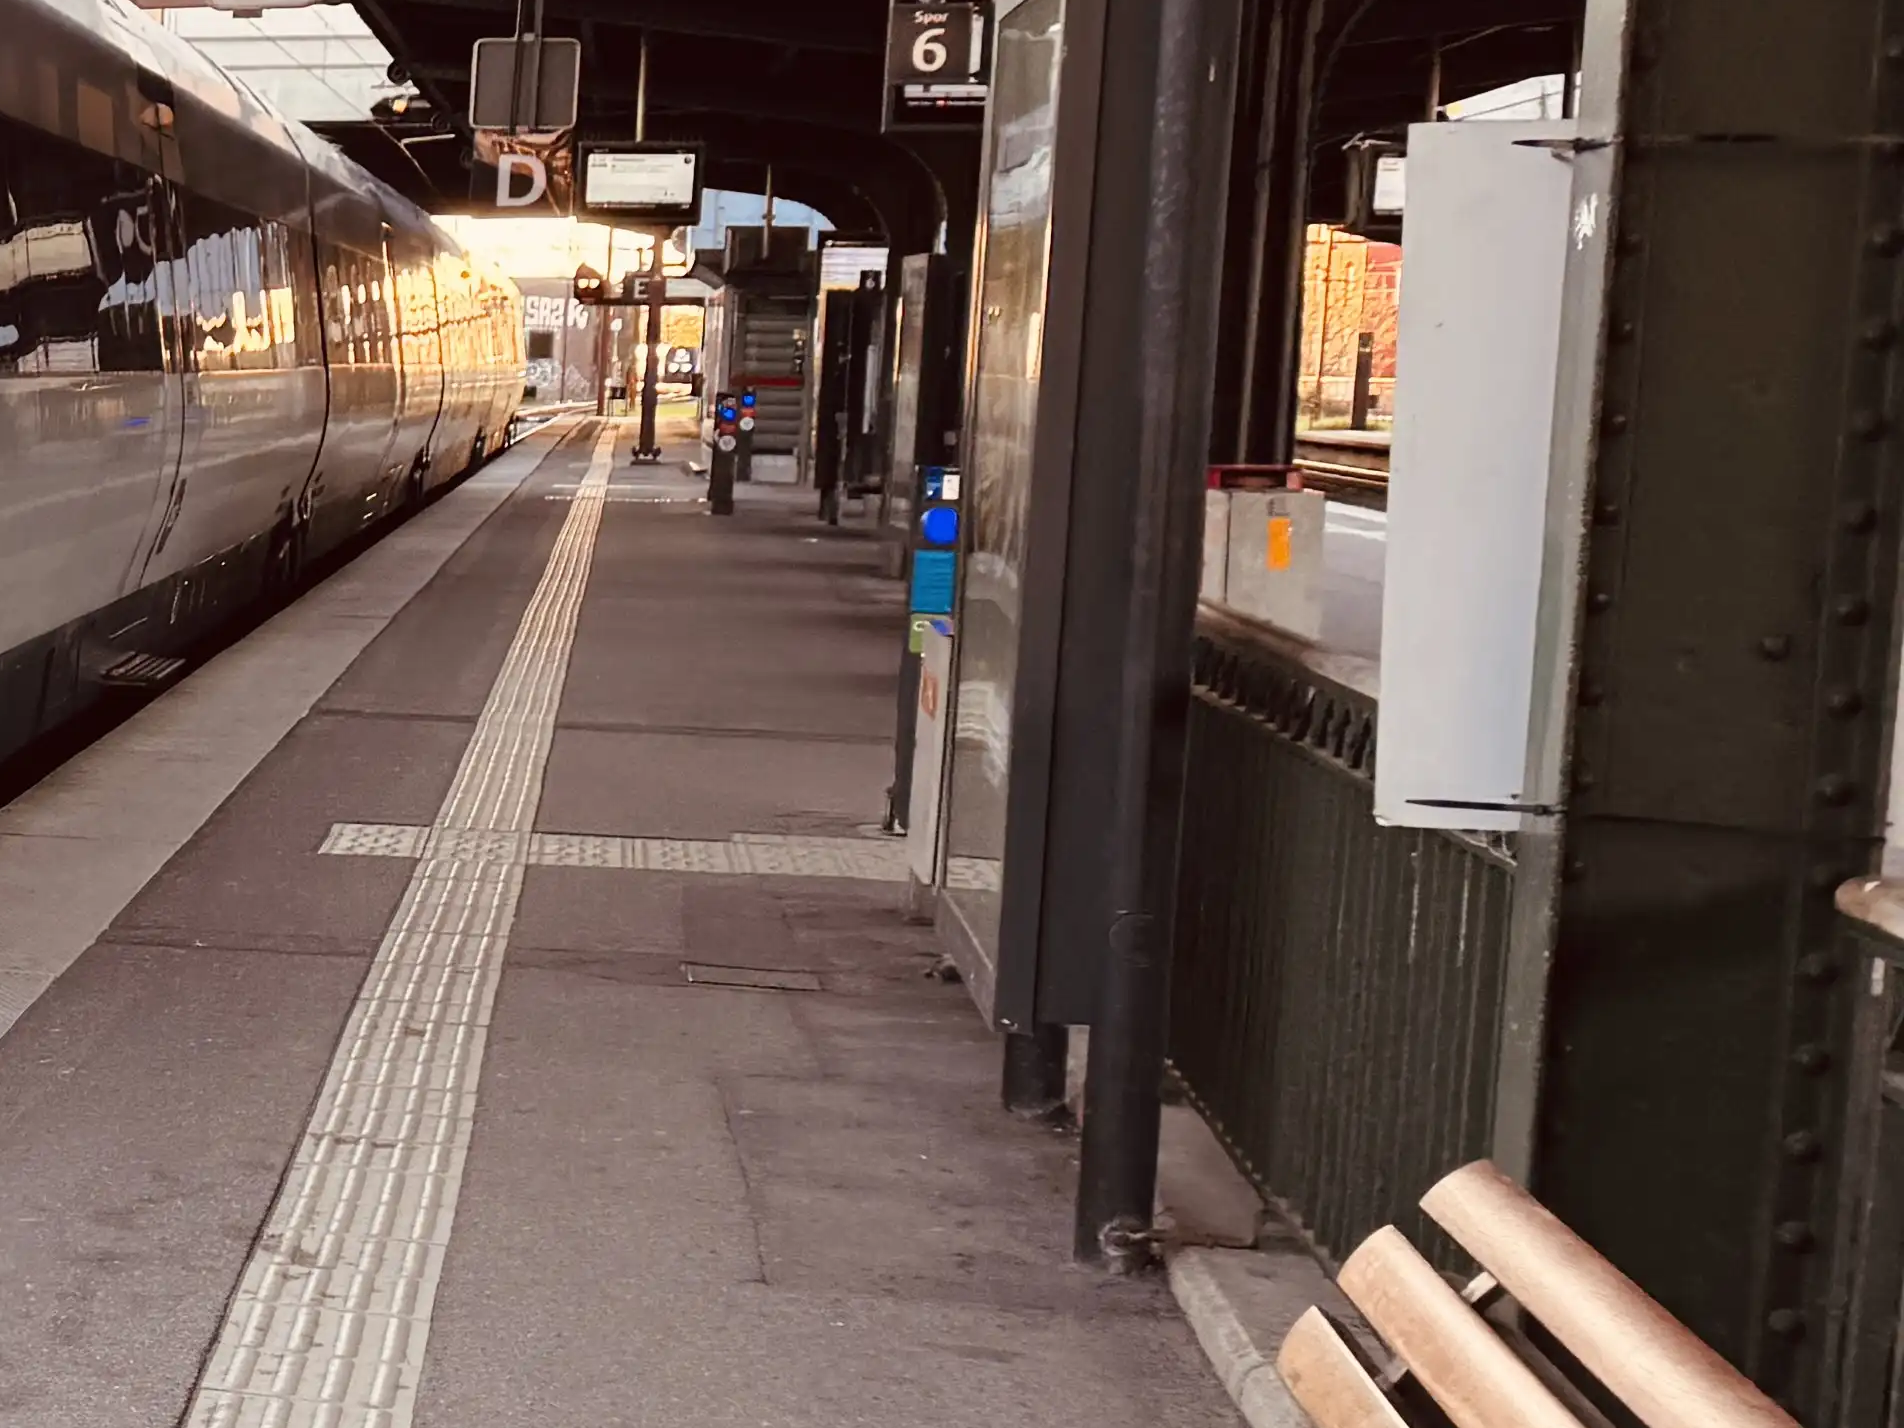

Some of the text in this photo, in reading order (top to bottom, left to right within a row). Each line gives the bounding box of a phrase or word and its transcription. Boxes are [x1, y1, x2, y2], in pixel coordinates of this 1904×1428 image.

[914, 10, 949, 24] Spor
[913, 28, 947, 72] 6
[496, 153, 547, 207] D
